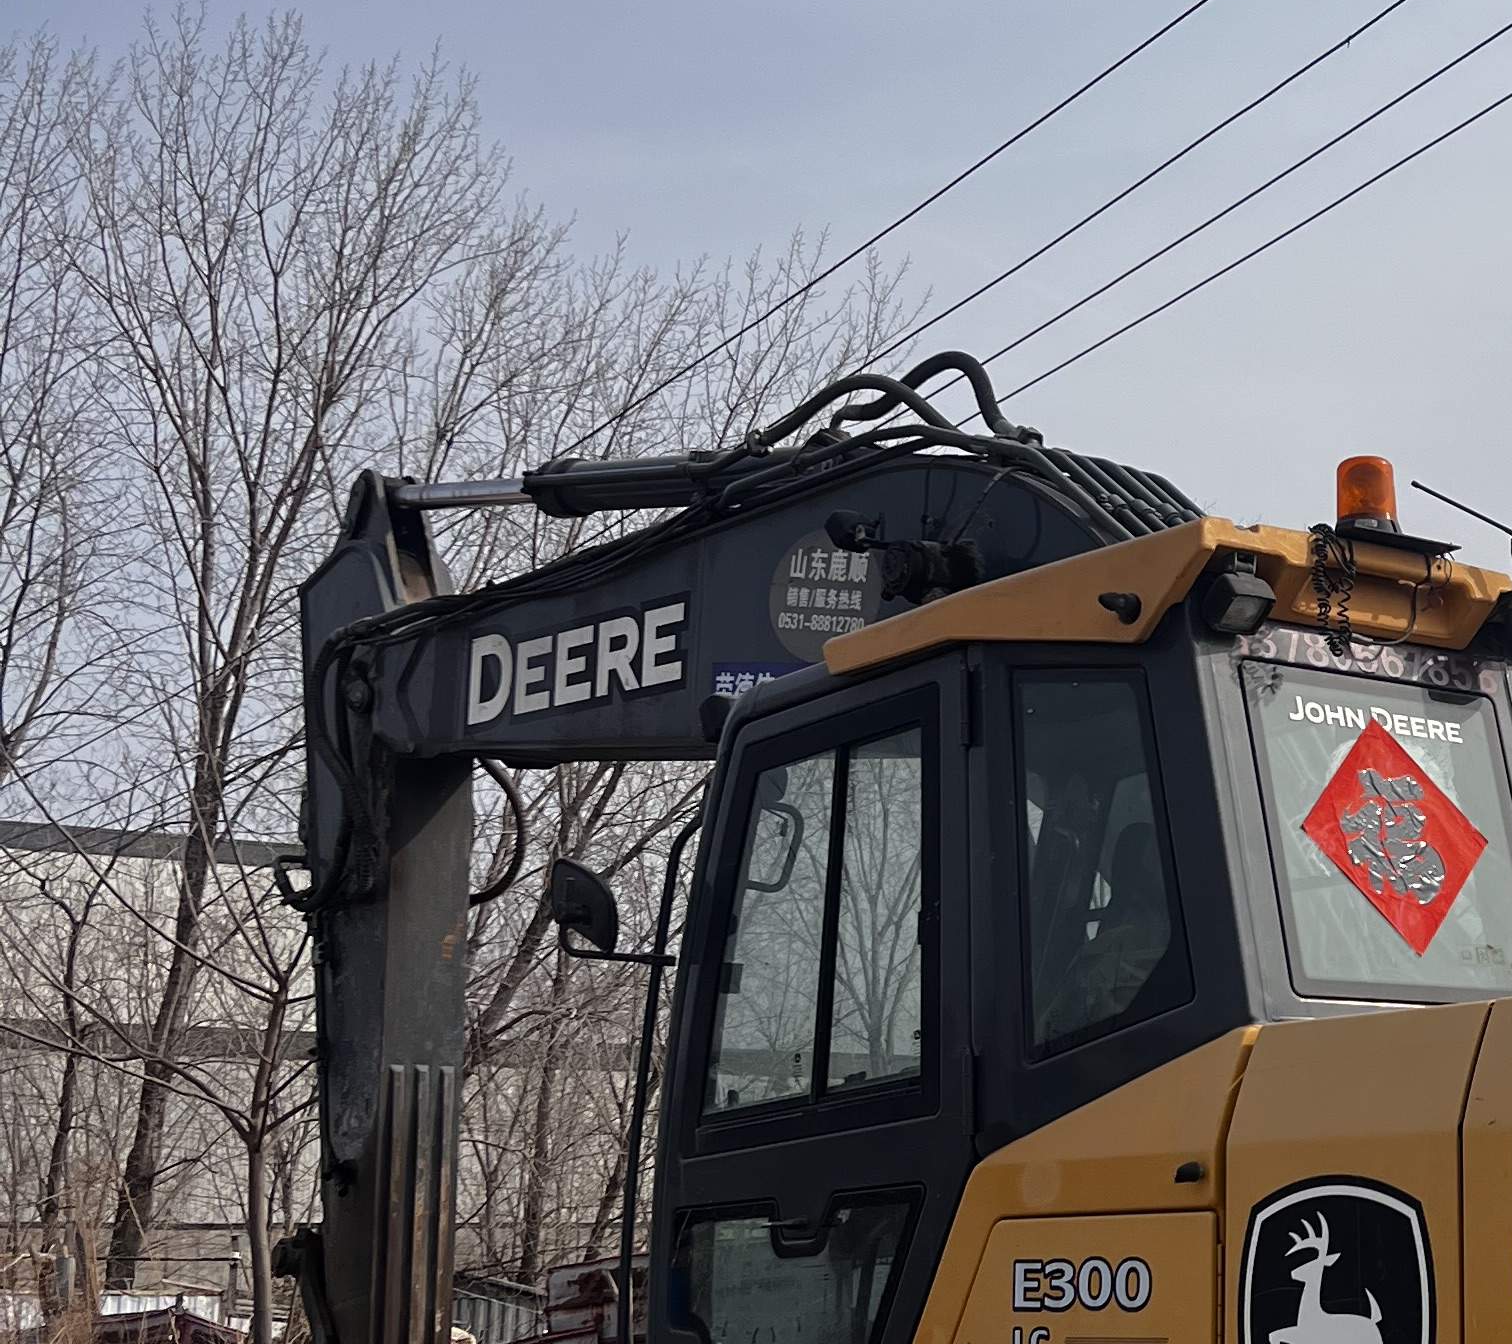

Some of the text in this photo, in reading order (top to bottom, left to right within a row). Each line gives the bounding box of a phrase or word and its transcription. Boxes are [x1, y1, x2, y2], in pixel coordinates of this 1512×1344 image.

[789, 548, 870, 584] 山东鹿顺
[467, 602, 685, 726] DEERE
[1289, 696, 1464, 744] JOHN DEERE
[1012, 1258, 1152, 1314] E300
